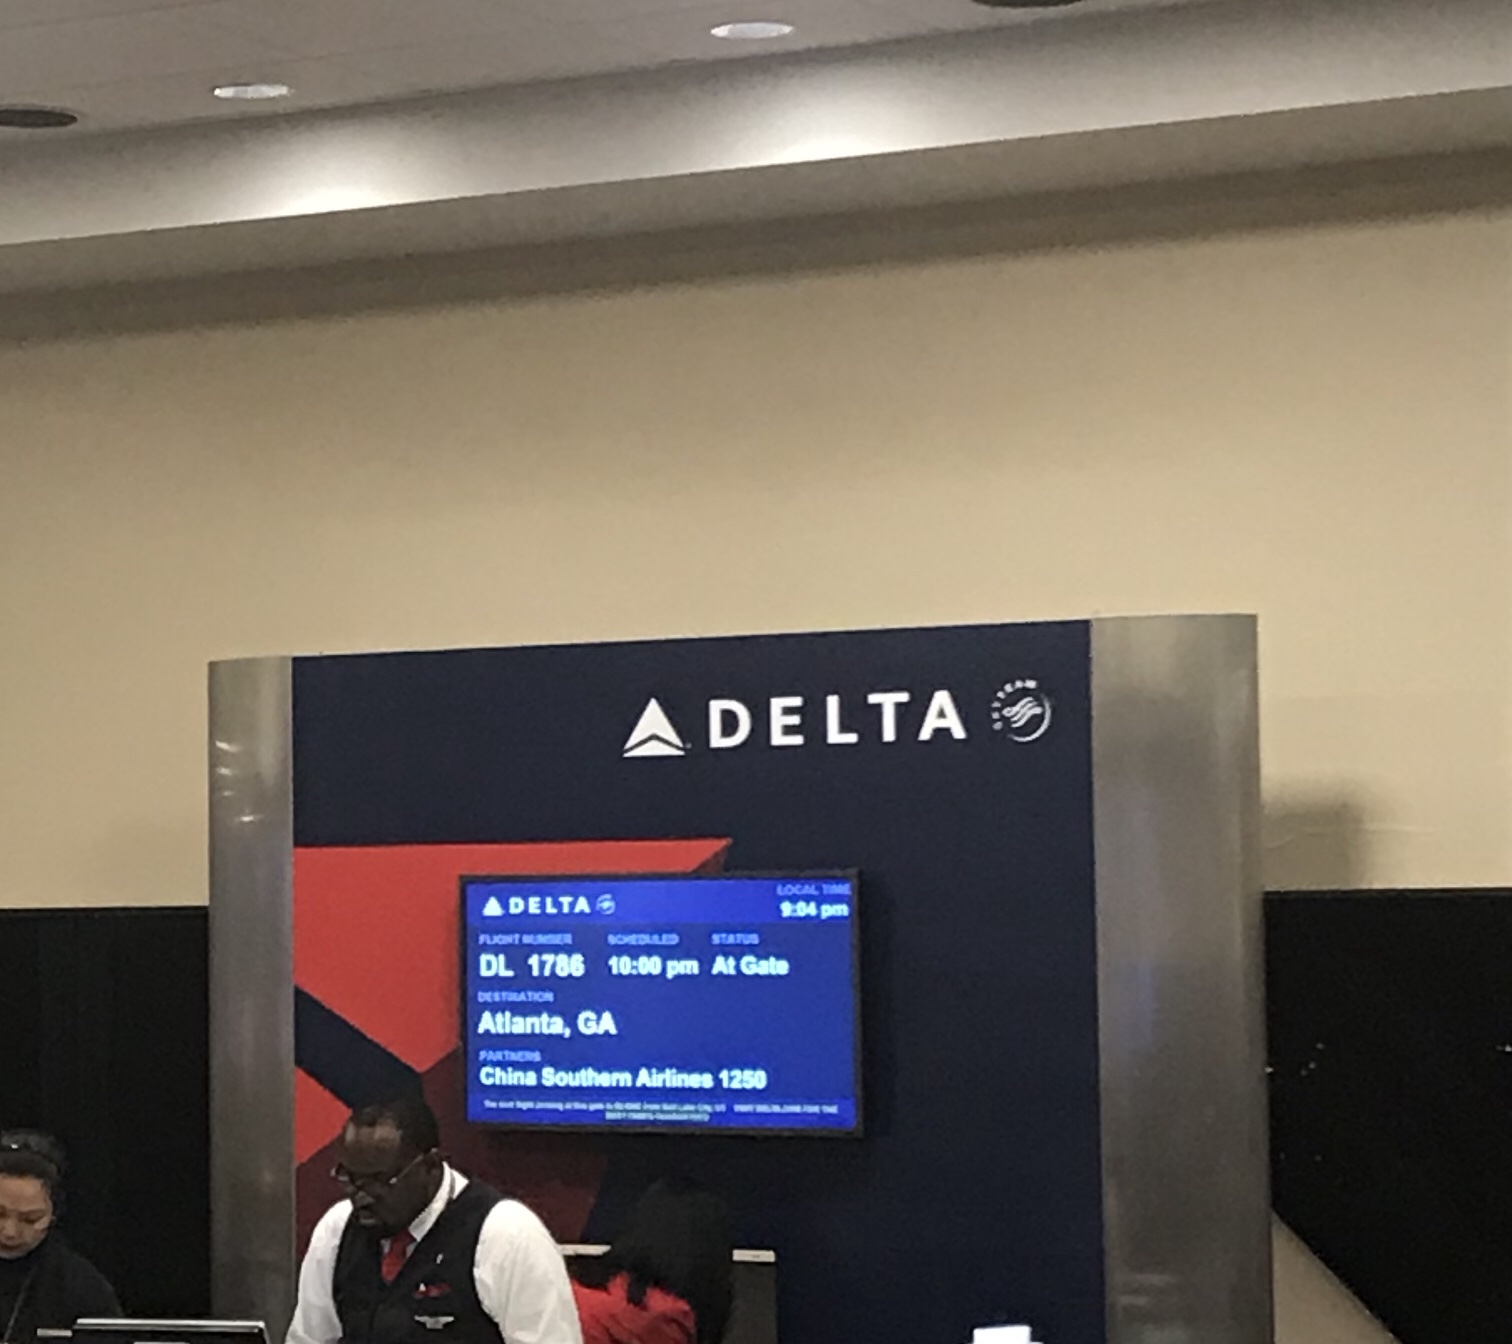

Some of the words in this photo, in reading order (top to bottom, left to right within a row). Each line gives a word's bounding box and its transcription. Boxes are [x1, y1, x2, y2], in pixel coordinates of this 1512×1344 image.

[708, 689, 967, 748] DELTA
[508, 896, 591, 914] DELTA
[820, 904, 849, 919] pm
[478, 933, 520, 945] FLIGHT
[607, 933, 680, 945] SCHEDULED
[711, 933, 759, 945] STATUS
[479, 953, 515, 977] DL
[527, 953, 585, 977] 1786
[608, 955, 662, 975] 10:00
[666, 959, 699, 979] pm
[711, 955, 737, 975] At
[740, 955, 789, 975] Gate
[477, 991, 554, 1002] DESTINATION
[477, 1010, 571, 1038] Atlanta,
[577, 1010, 617, 1035] GA
[479, 1066, 537, 1086] China
[541, 1067, 632, 1087] Southern
[635, 1068, 714, 1088] Airlines
[718, 1069, 767, 1089] 1250
